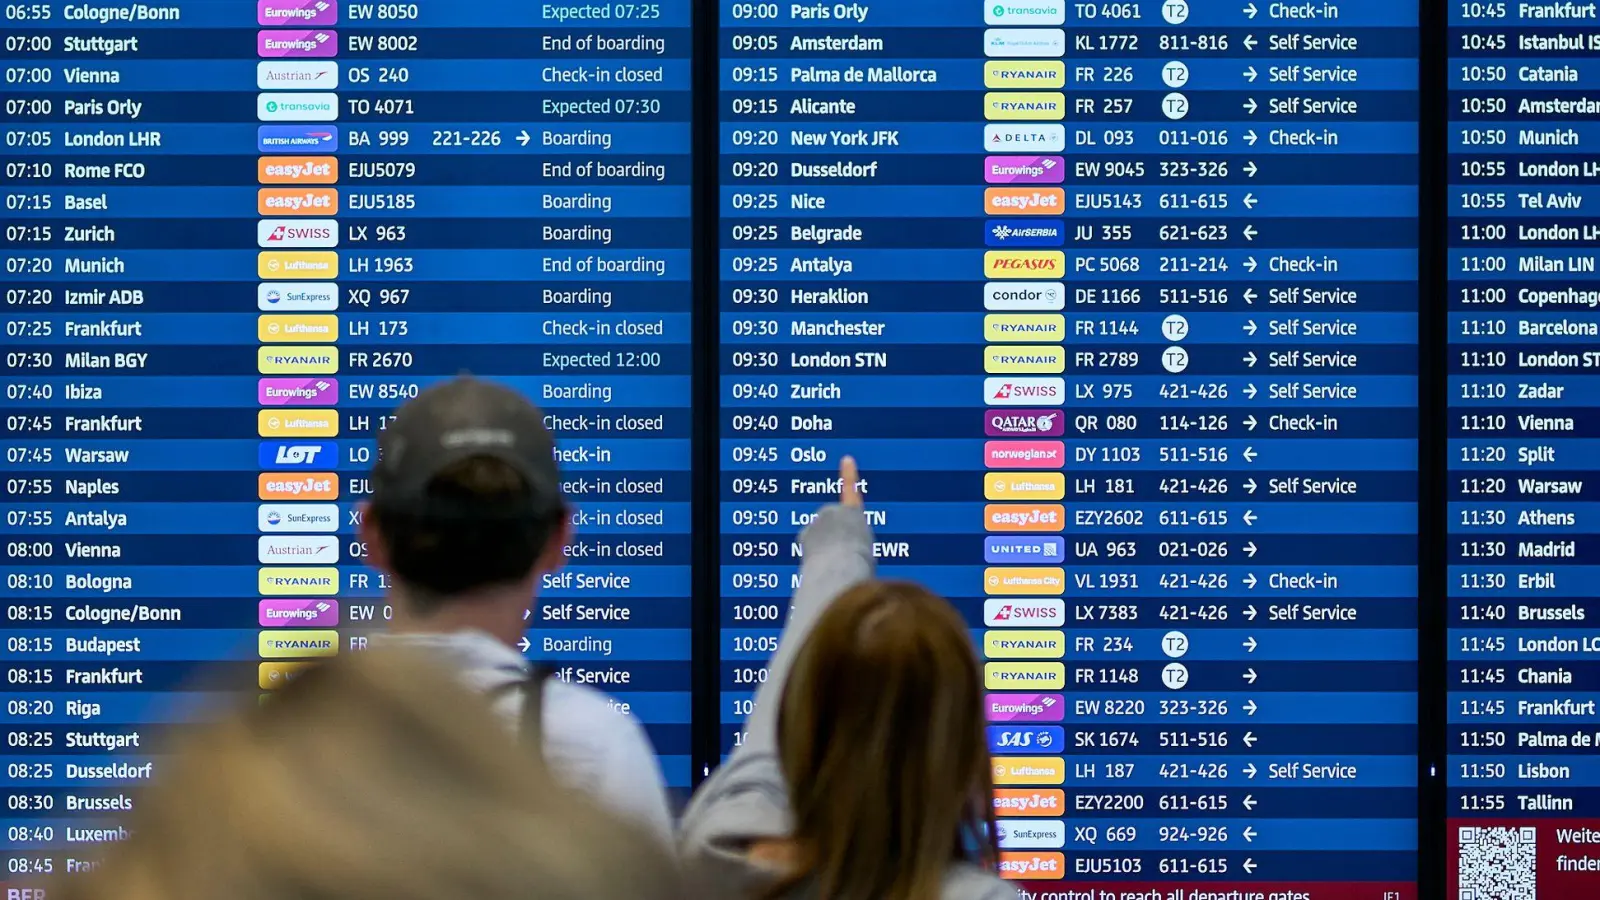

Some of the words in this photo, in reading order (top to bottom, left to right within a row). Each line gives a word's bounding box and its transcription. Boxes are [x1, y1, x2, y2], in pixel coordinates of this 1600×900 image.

[5, 4, 51, 20] 06:55
[63, 3, 180, 24] Cologne/Bonn
[264, 6, 318, 20] Eurowings
[348, 4, 374, 20] EW
[377, 3, 419, 20] 8050
[542, 3, 611, 23] Expected
[614, 3, 660, 19] 07:25
[1461, 2, 1506, 18] 10:45
[1519, 1, 1597, 19] Frankfurt
[732, 35, 778, 51] 09:05
[789, 34, 884, 51] Amsterdam
[1075, 35, 1095, 51] KL
[1099, 34, 1139, 50] 1772
[1159, 34, 1229, 51] 811-816
[1269, 33, 1300, 51] Self
[1302, 33, 1358, 51] Service
[5, 67, 52, 83] 07:00
[63, 66, 120, 84] Vienna
[265, 70, 312, 81] Austrian
[348, 67, 370, 83] OS
[378, 67, 409, 83] 240
[542, 66, 610, 83] Check-in
[614, 66, 663, 83] closed
[732, 66, 778, 83] 09:15
[790, 66, 841, 83] Palma
[843, 66, 864, 83] de
[867, 65, 937, 83] Mallorca
[1000, 70, 1057, 79] RYANAIR
[1075, 66, 1095, 82] FR
[1103, 66, 1134, 82] 226
[1165, 66, 1186, 83] T2
[1269, 65, 1300, 82] Self
[1302, 65, 1358, 82] Service
[1461, 65, 1506, 82] 10:50
[1518, 65, 1578, 82] Catania
[1461, 97, 1507, 114] 10:50
[6, 130, 52, 147] 07:05
[64, 130, 125, 147] London
[128, 131, 161, 147] LHR
[349, 130, 371, 146] BA
[378, 130, 409, 146] 999
[432, 130, 502, 146] 221-226
[542, 129, 612, 150] Boarding
[732, 130, 779, 146] 09:20
[791, 130, 828, 146] New
[829, 129, 869, 146] York
[871, 130, 899, 146] JFK
[1004, 133, 1047, 142] DELTA
[1075, 130, 1097, 146] DL
[1103, 129, 1134, 146] 093
[1159, 129, 1228, 146] 011-016
[1269, 128, 1338, 146] Check-in
[1461, 192, 1506, 209] 10:55
[1517, 192, 1544, 209] Tel
[1545, 191, 1582, 209] Aviv
[6, 225, 52, 242] 07:15
[64, 225, 115, 242] Zurich
[287, 227, 331, 240] SWISS
[349, 225, 368, 241] LX
[375, 225, 406, 241] 963
[542, 224, 612, 245] Boarding
[732, 225, 778, 241] 09:25
[791, 224, 863, 245] Belgrade
[1074, 225, 1093, 241] JU
[1102, 225, 1132, 241] 355
[1159, 224, 1228, 241] 621-623
[1461, 256, 1506, 272] 11:00
[1518, 255, 1564, 272] Milan
[1568, 256, 1595, 272] LIN
[6, 289, 53, 305] 07:20
[65, 288, 106, 305] Izmir
[108, 289, 144, 305] ADB
[286, 291, 331, 303] SunExpress
[348, 288, 371, 308] XQ
[379, 288, 410, 305] 967
[542, 287, 612, 308] Boarding
[1461, 383, 1506, 399] 11:10
[1517, 382, 1565, 399] Zadar
[732, 415, 779, 431] 09:40
[791, 414, 833, 431] Doha
[991, 415, 1037, 430] QATAR
[1075, 415, 1098, 434] QR
[1106, 415, 1137, 431] 080
[1160, 415, 1228, 431] 114-126
[1269, 414, 1338, 431] Check-in
[7, 447, 52, 463] 07:45
[64, 447, 130, 463] Warsaw
[274, 444, 323, 465] LOT
[349, 447, 370, 463] LO
[552, 445, 612, 463] heck-in
[1461, 446, 1506, 462] 11:20
[1518, 445, 1555, 466] Split
[732, 478, 778, 494] 09:45
[790, 477, 869, 495] Frankfrt
[1075, 478, 1095, 494] LH
[1105, 478, 1135, 494] 181
[1159, 478, 1228, 494] 421-426
[1268, 477, 1300, 494] Self
[1302, 477, 1357, 494] Service
[732, 541, 779, 557] 09:50
[872, 541, 910, 558] EWR
[990, 545, 1042, 554] UNITED
[1075, 541, 1099, 558] UA
[1106, 541, 1137, 557] 963
[1158, 541, 1228, 558] 021-026
[1461, 541, 1506, 557] 11:30
[1518, 540, 1575, 558] Madrid
[7, 573, 53, 589] 08:10
[65, 572, 132, 593] Bologna
[274, 576, 331, 586] RYANAIR
[349, 573, 369, 589] FR
[542, 572, 573, 589] Self
[576, 572, 631, 589] Service
[732, 573, 779, 589] 09:50
[1074, 573, 1096, 589] VL
[1099, 573, 1139, 589] 1931
[1159, 573, 1228, 589] 421-426
[1269, 572, 1338, 589] Check-in
[1460, 668, 1505, 684] 11:45
[1517, 667, 1572, 684] Chania
[7, 700, 54, 715] 08:20
[66, 699, 101, 720] Riga
[996, 731, 1034, 747] SAS
[1074, 731, 1095, 747] SK
[1099, 731, 1140, 747] 1674
[1159, 731, 1228, 747] 511-516
[8, 763, 53, 779] 08:25
[66, 762, 153, 779] Dusseldorf
[1460, 763, 1506, 778] 11:50
[1518, 762, 1570, 779] Lisbon
[993, 793, 1058, 811] easyJet
[1075, 794, 1144, 810] EZY2200
[1159, 794, 1228, 810] 611-615
[1460, 794, 1505, 810] 11:55
[1516, 793, 1573, 811] Tallinn
[8, 826, 54, 842] 08:40
[1040, 888, 1096, 900] control
[1098, 890, 1116, 900] to
[1119, 888, 1162, 900] reach
[1166, 888, 1185, 900] all
[1188, 888, 1265, 900] departure
[1268, 889, 1311, 900] gates
